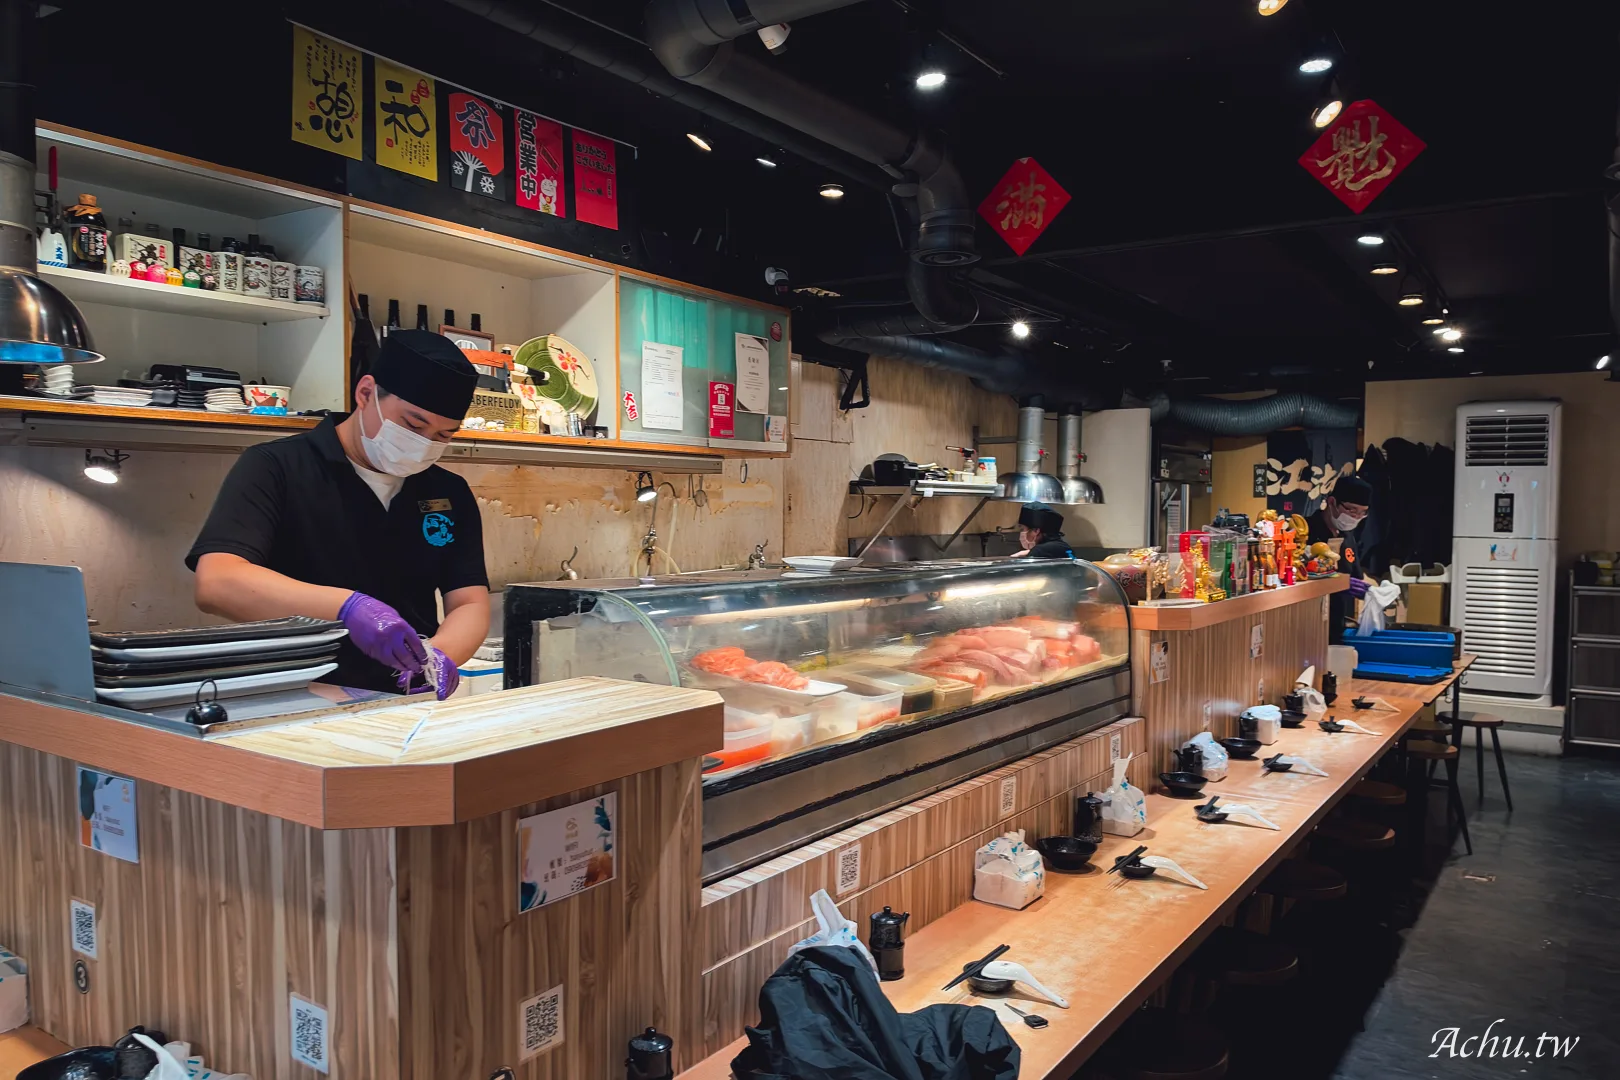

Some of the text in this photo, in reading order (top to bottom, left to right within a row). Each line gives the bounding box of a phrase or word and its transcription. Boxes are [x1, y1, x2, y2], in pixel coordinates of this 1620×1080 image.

[455, 100, 497, 149] 祭
[516, 109, 538, 200] 営業中
[575, 142, 607, 160] ありがとう
[575, 155, 614, 174] ございました
[470, 394, 520, 409] ABERFELDY
[624, 391, 638, 420] 大吉
[77, 966, 86, 988] 3
